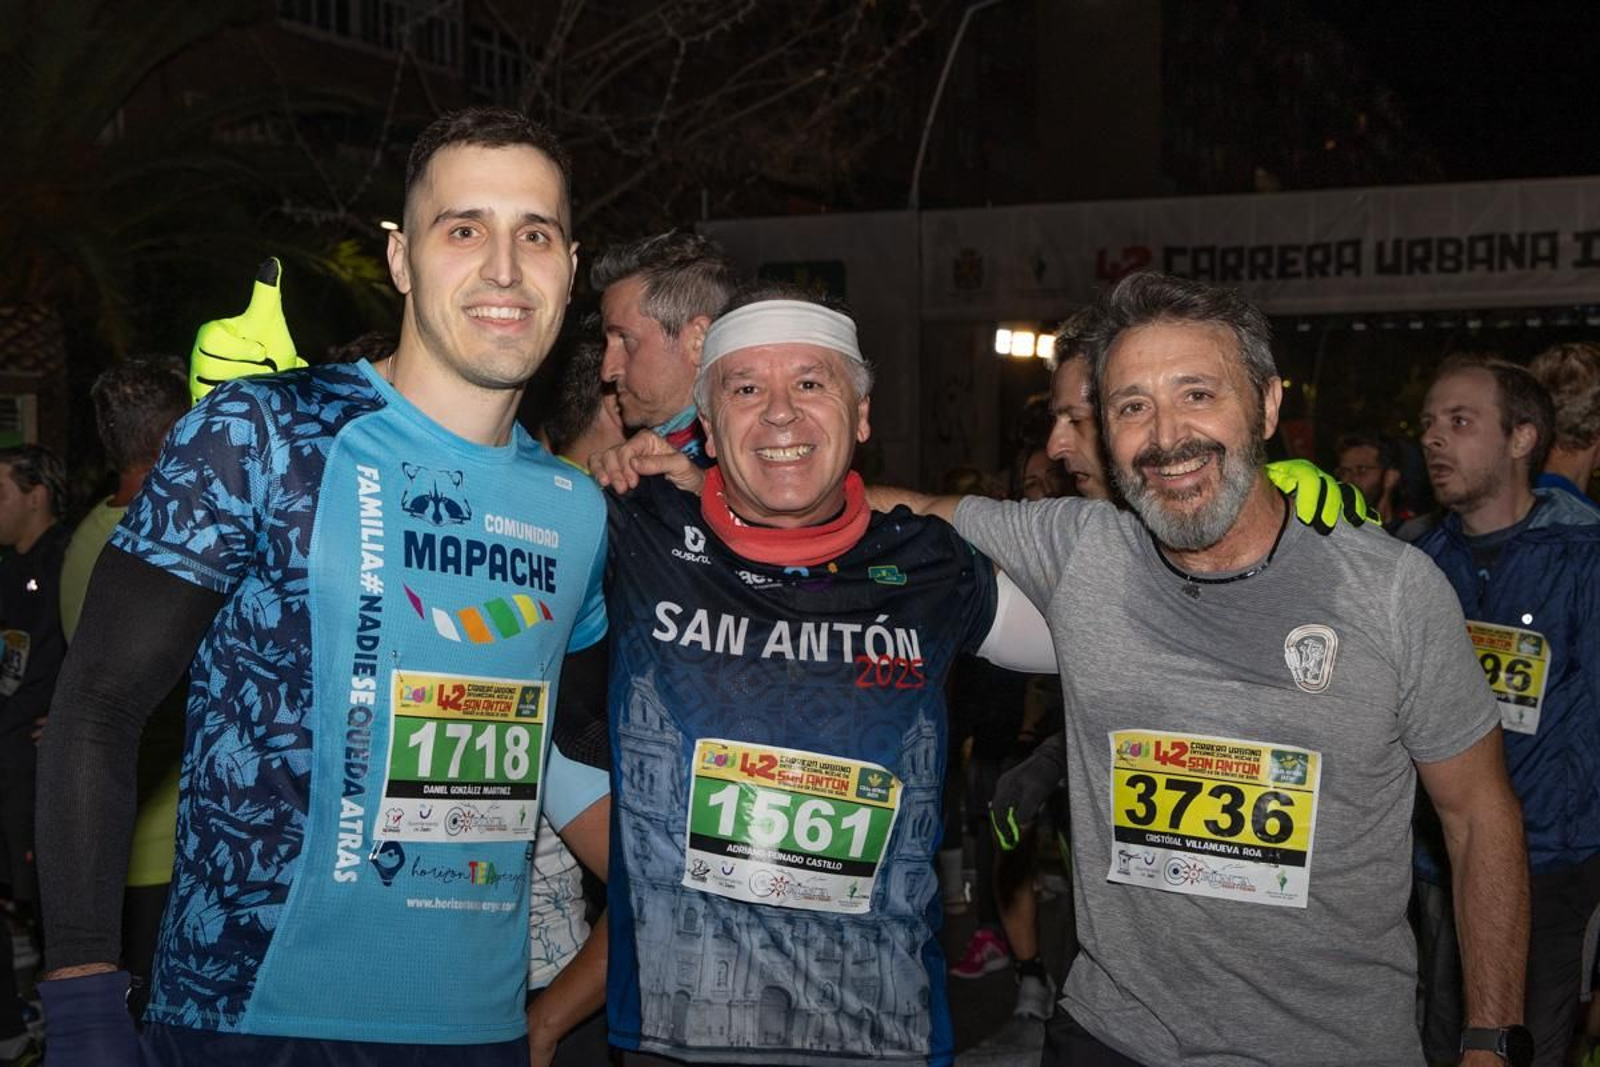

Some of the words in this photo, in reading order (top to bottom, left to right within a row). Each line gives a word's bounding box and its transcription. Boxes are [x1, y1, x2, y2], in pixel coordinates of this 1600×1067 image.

[1163, 239, 1363, 281] CARRERA
[1376, 231, 1558, 275] URBANA
[1573, 231, 1600, 267] I
[484, 513, 558, 548] COMUNIDAD
[403, 530, 557, 593] MAPACHE
[652, 600, 749, 655] SAN
[760, 614, 924, 667] ANTÓN
[854, 653, 925, 688] 2025
[437, 684, 466, 711] 42
[463, 699, 481, 709] SAN
[481, 701, 512, 712] ANTON
[408, 721, 530, 781] 1718
[1154, 740, 1188, 768] 42
[1190, 742, 1227, 753] CARRERA
[1228, 747, 1261, 756] URBANA
[740, 752, 778, 781] 42
[1187, 757, 1213, 770] SAN
[1215, 760, 1260, 775] ANTON
[423, 785, 448, 794] DANIEL
[450, 785, 481, 795] GONZÁLEZ
[777, 770, 803, 784] SAN
[805, 774, 849, 792] ANTON
[709, 784, 872, 858] 1561
[1124, 774, 1295, 844] 3736
[1185, 839, 1240, 855] VILLANUEVA
[1242, 847, 1262, 858] ROA
[806, 857, 843, 870] CASTILLO
